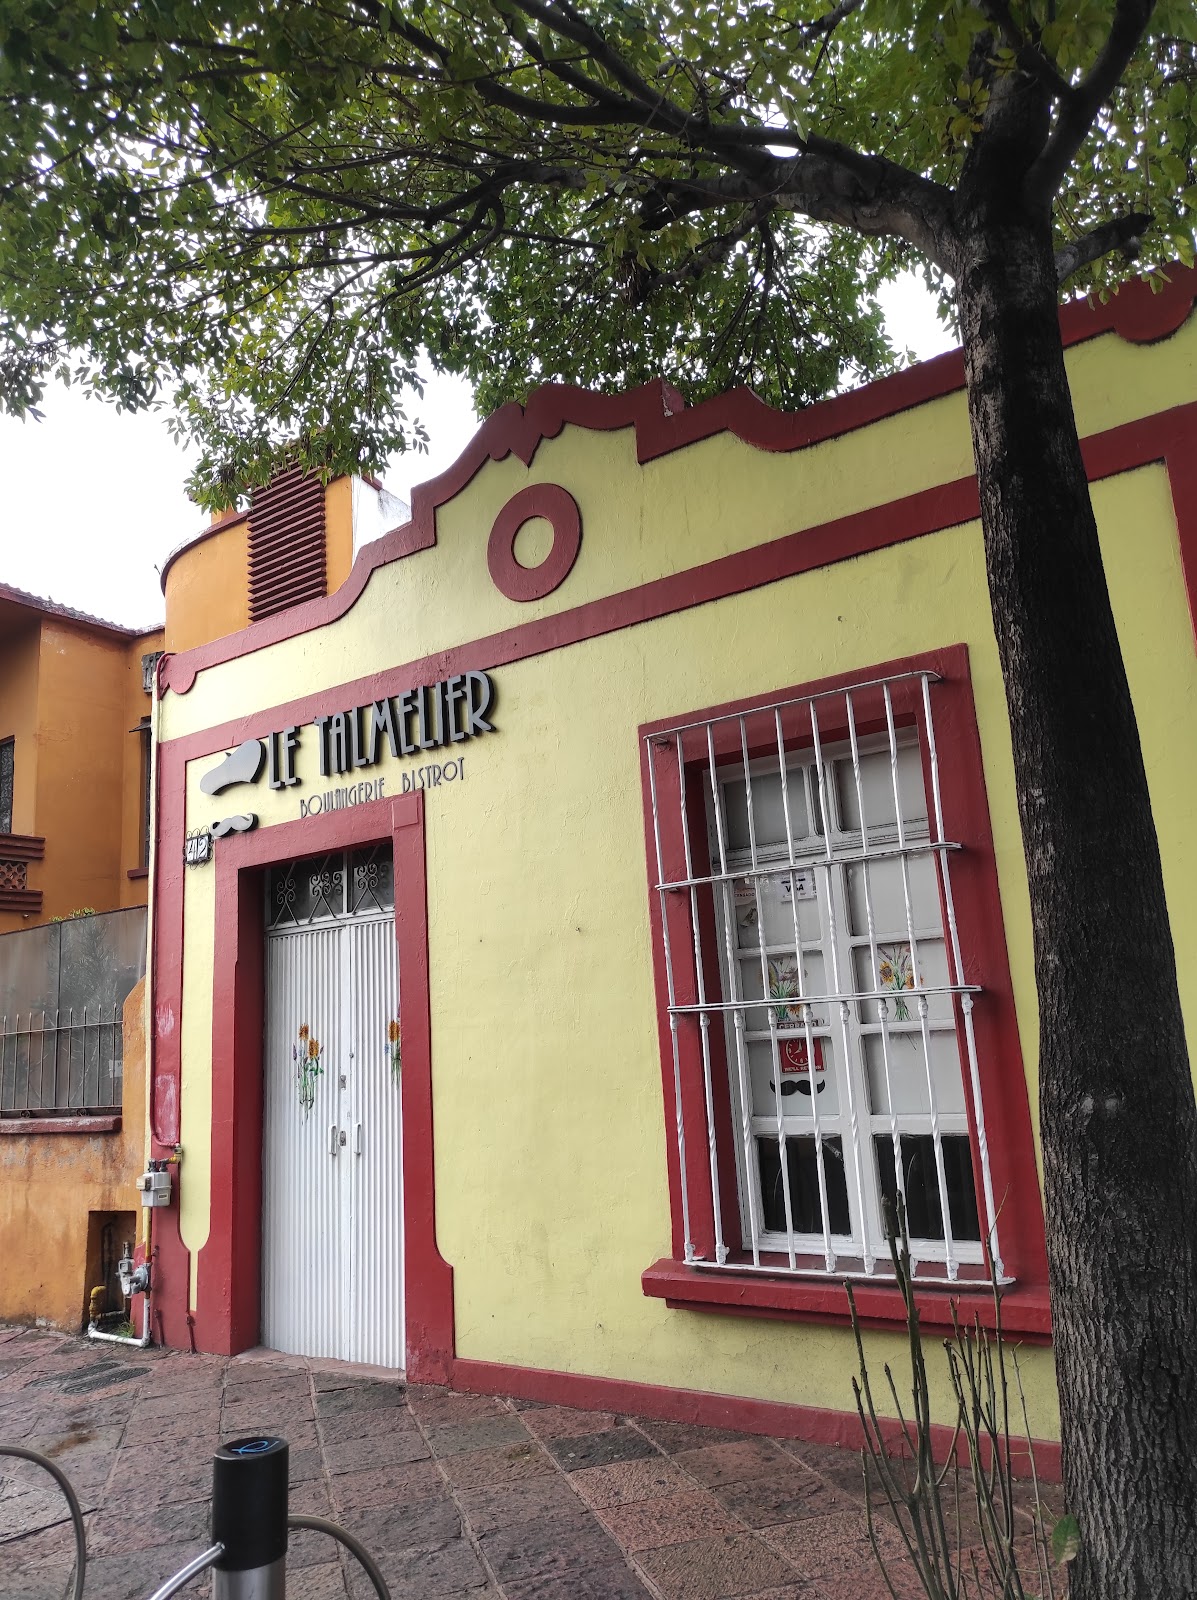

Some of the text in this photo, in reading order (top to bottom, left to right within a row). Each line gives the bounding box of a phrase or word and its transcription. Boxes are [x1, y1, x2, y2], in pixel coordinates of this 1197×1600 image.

[268, 670, 497, 790] LE TALMELIER
[300, 757, 464, 819] BOULANGERIE BISTROT
